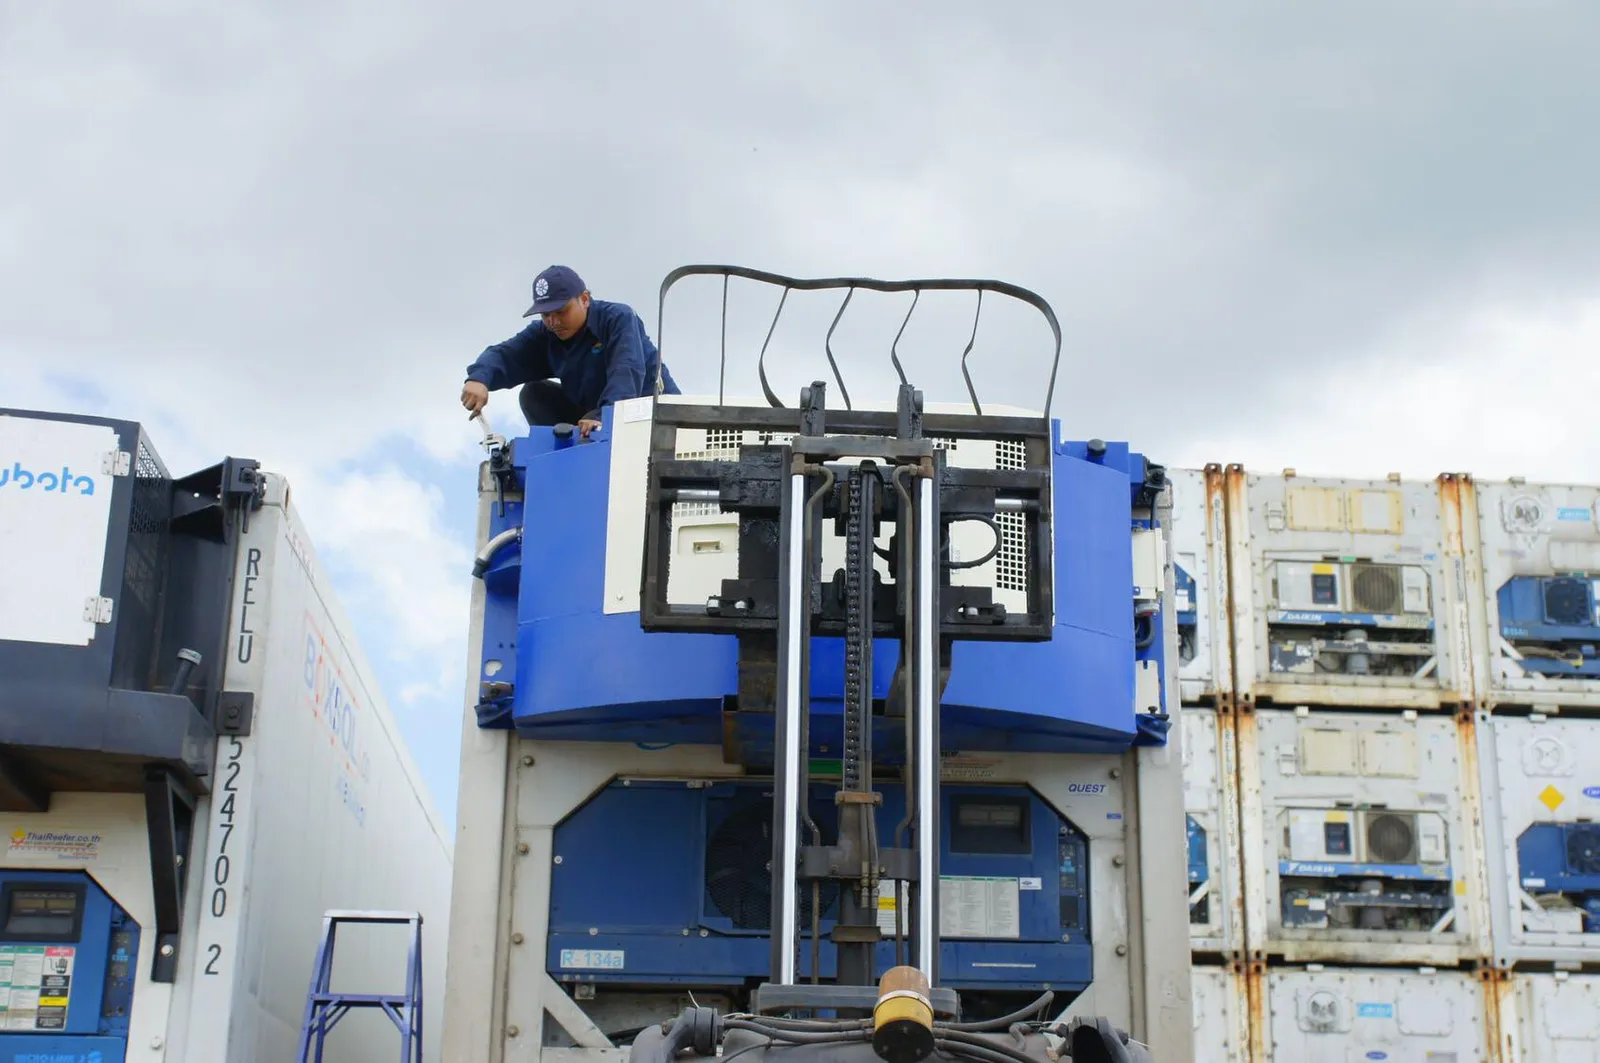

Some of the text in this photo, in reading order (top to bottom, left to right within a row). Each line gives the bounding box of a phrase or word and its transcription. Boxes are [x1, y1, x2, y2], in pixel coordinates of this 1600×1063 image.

[238, 547, 261, 663] RELU
[1068, 783, 1107, 793] QUEST
[26, 831, 101, 842] ThaiReefer.co.th
[204, 943, 222, 975] 2
